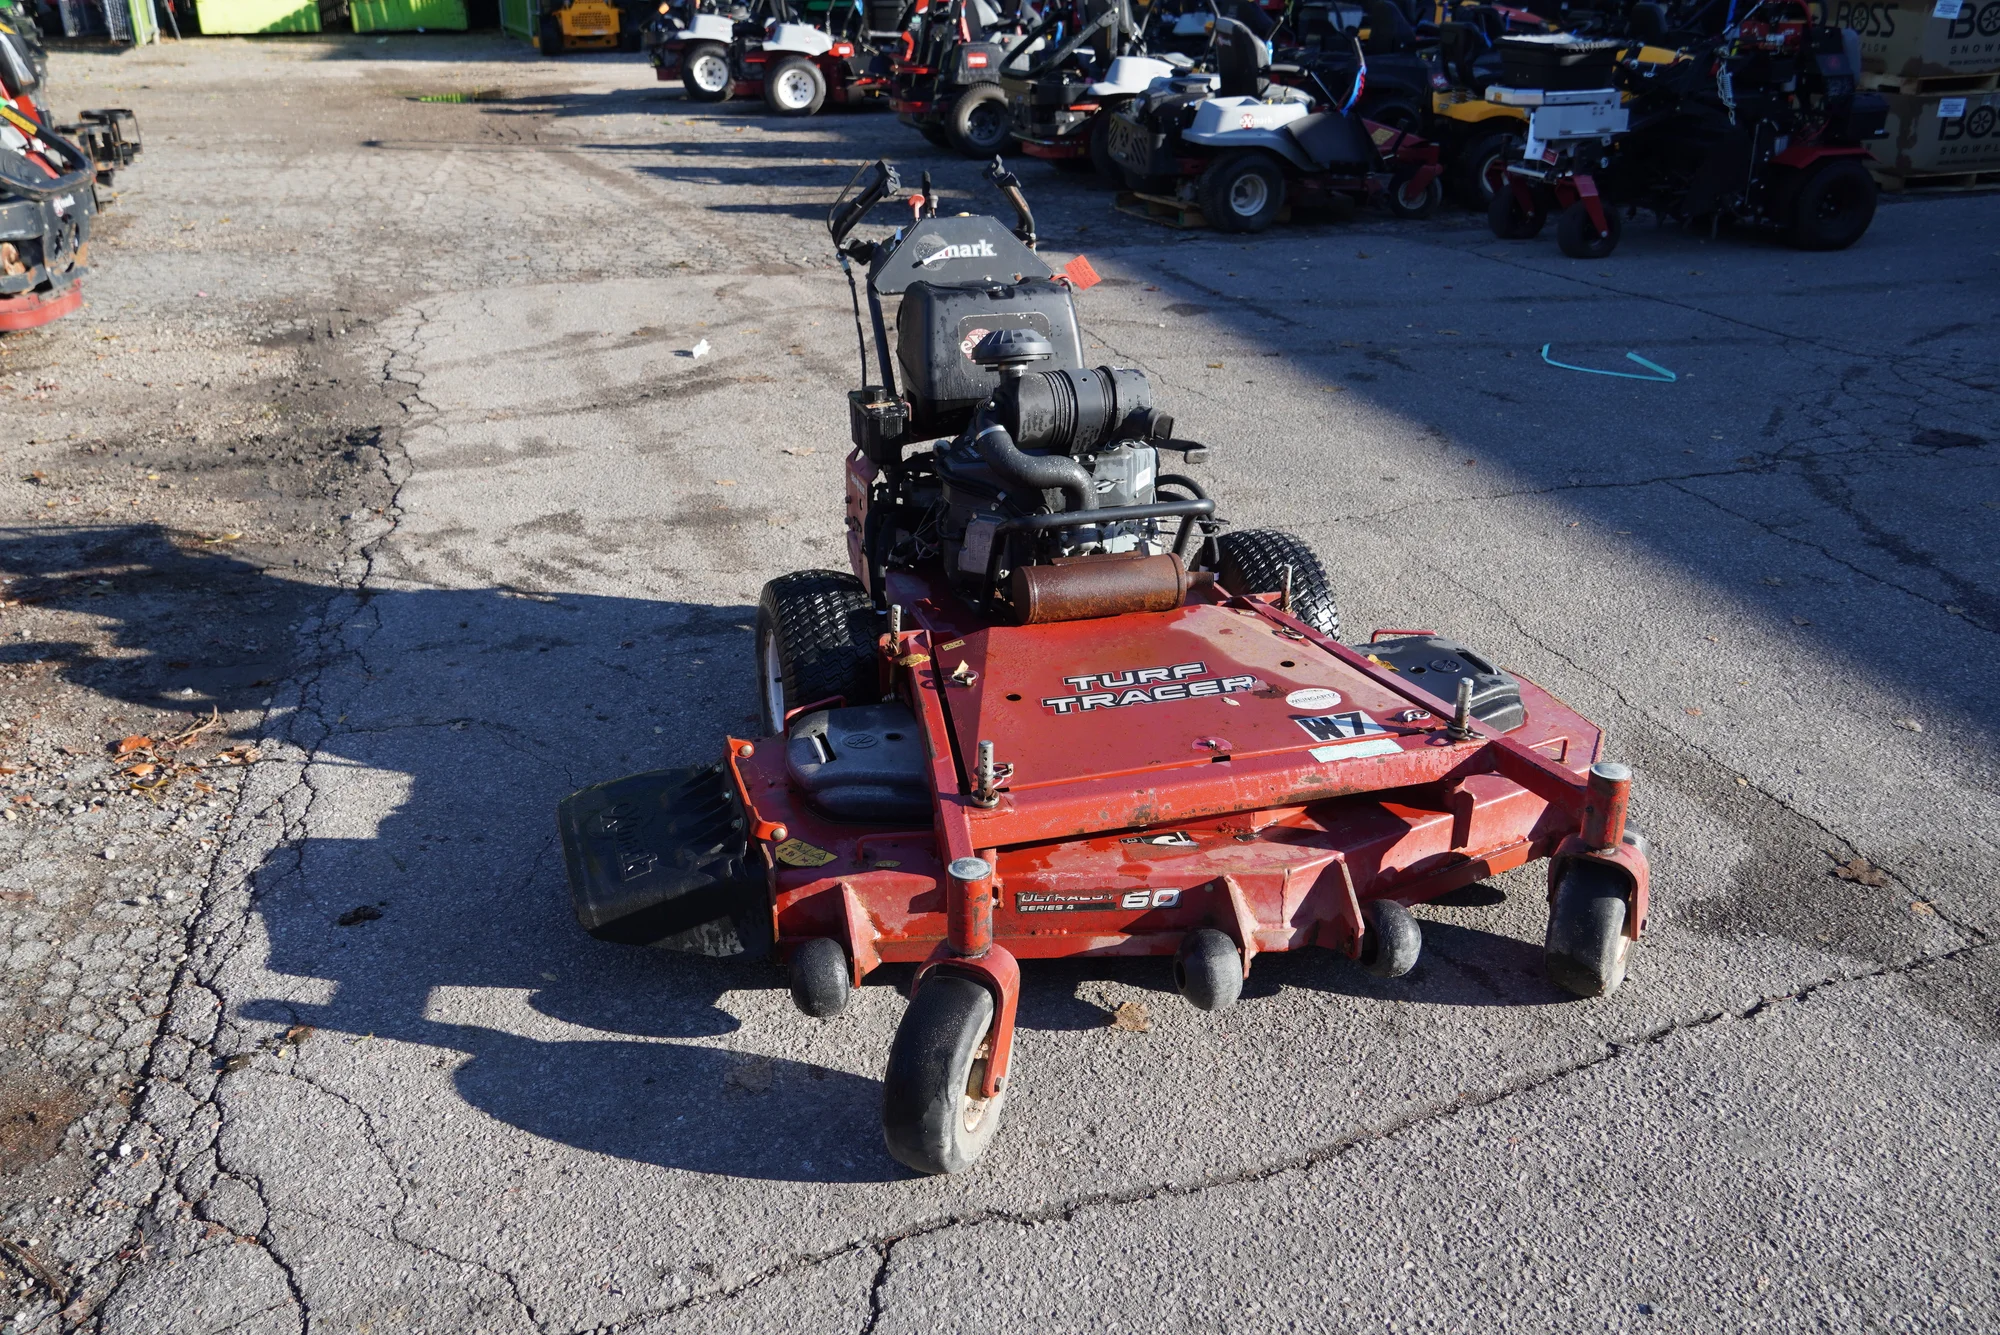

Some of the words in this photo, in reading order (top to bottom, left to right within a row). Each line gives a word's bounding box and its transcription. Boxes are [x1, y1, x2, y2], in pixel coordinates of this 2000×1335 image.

[1835, 1, 1899, 38] BOSS
[1066, 662, 1205, 691] TURF
[1045, 676, 1256, 714] TRACER
[1298, 712, 1366, 741] W7
[1020, 904, 1063, 912] SERIES
[1121, 888, 1181, 909] 60
